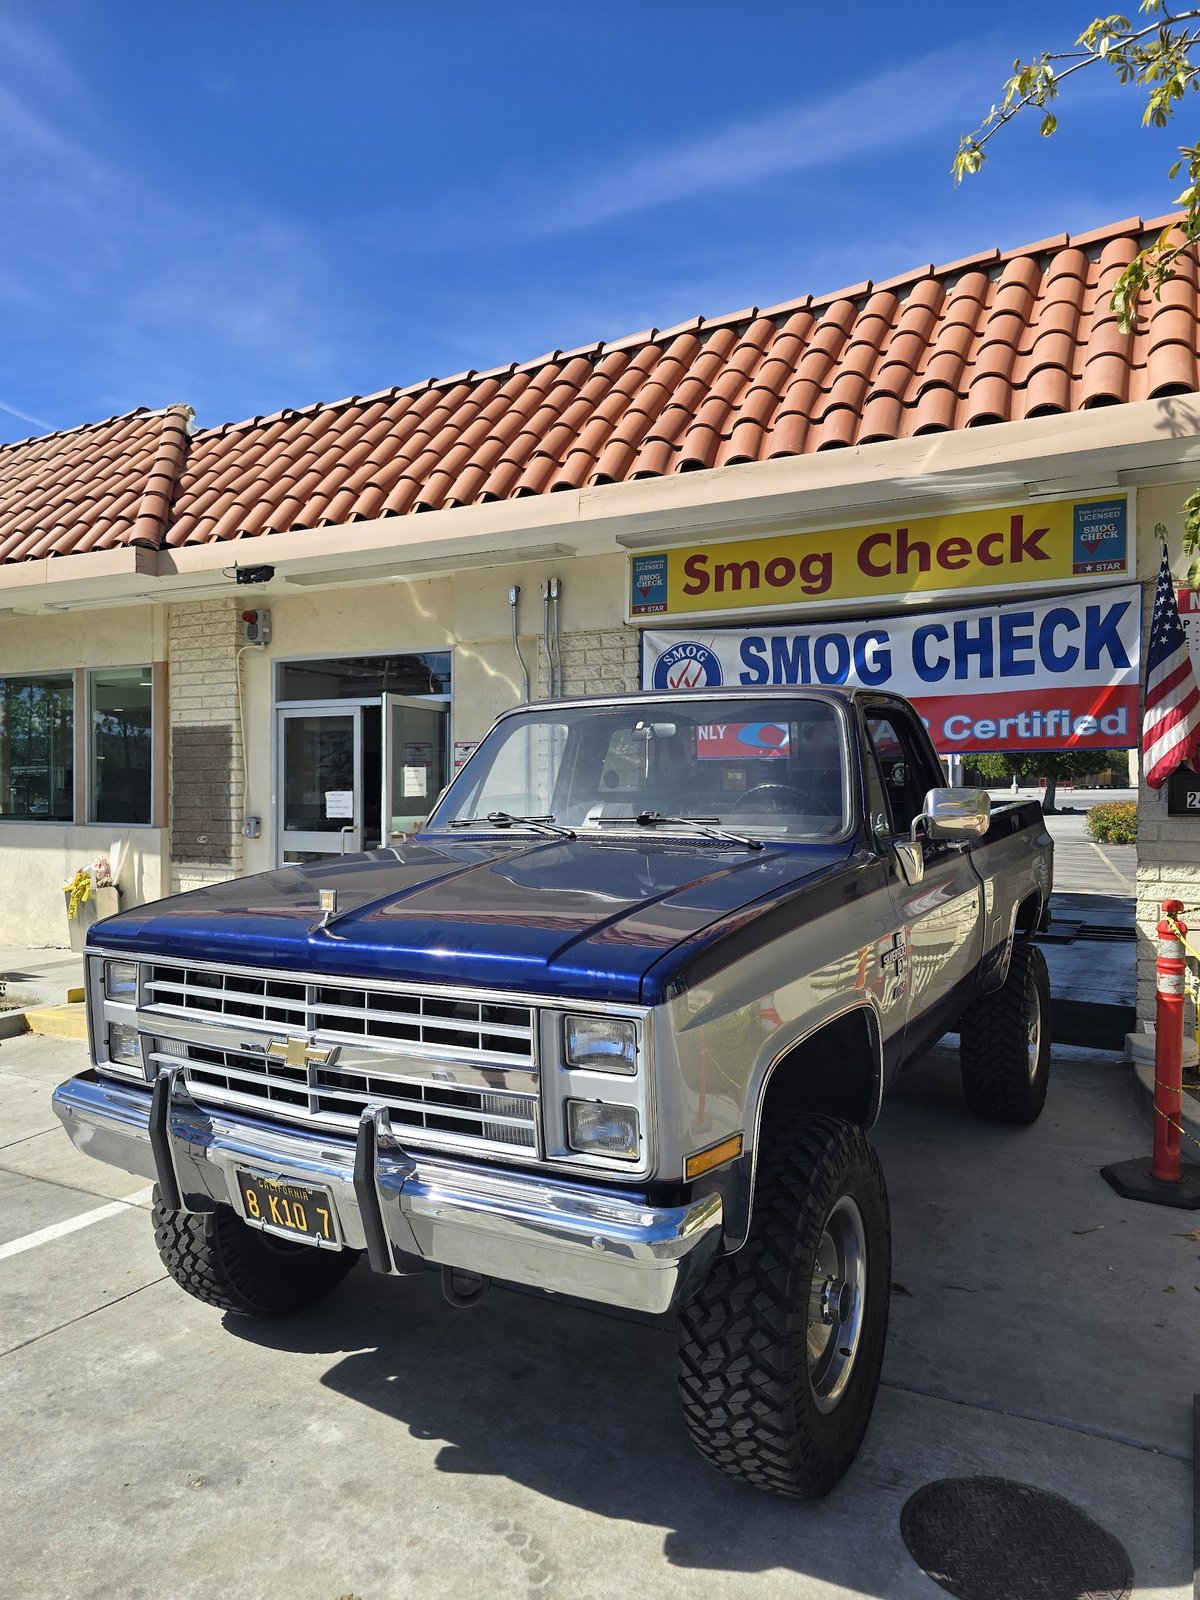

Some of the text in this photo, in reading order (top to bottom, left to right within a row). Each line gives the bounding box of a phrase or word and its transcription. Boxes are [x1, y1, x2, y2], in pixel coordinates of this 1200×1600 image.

[1080, 511, 1120, 521] LICENSED
[1083, 523, 1115, 533] SMOG
[1080, 531, 1118, 541] CHECK
[682, 514, 1051, 595] Smog Check
[636, 563, 664, 571] LICENSED
[1096, 562, 1120, 571] STAR
[639, 573, 660, 581] SMOG
[637, 579, 663, 588] CHECK
[739, 629, 892, 686] SMOG
[912, 601, 1131, 682] CHECK
[663, 646, 708, 665] SMOG
[943, 707, 1128, 741] Certified
[258, 1180, 309, 1200] CALIFORNIA
[246, 1189, 329, 1238] 8 K10 7
